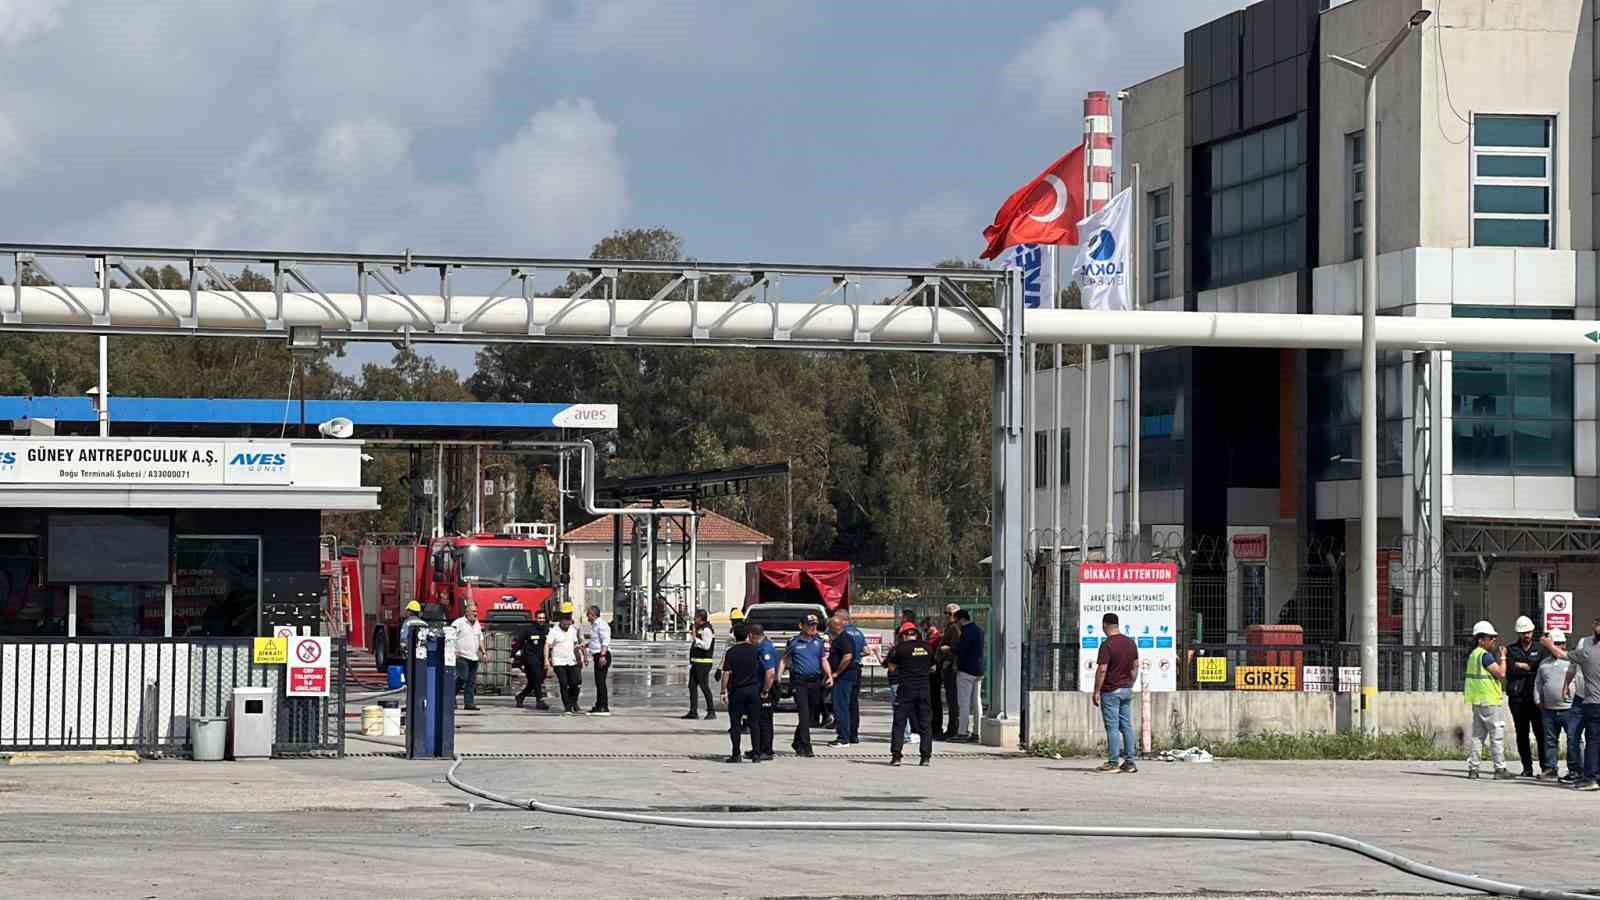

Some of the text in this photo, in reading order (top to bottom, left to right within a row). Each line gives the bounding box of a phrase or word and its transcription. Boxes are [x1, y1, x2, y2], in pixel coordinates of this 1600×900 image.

[575, 409, 607, 421] aves
[27, 445, 219, 467] GÜNEY ANTREPOCULUK A.Ş.
[230, 453, 286, 465] AVES
[59, 469, 79, 480] Doğu
[80, 469, 115, 480] Terminali
[117, 469, 141, 481] Şubesi
[148, 470, 190, 480] A33000071
[1083, 566, 1117, 580] DİKKAT
[1123, 568, 1172, 580] ATTENTION
